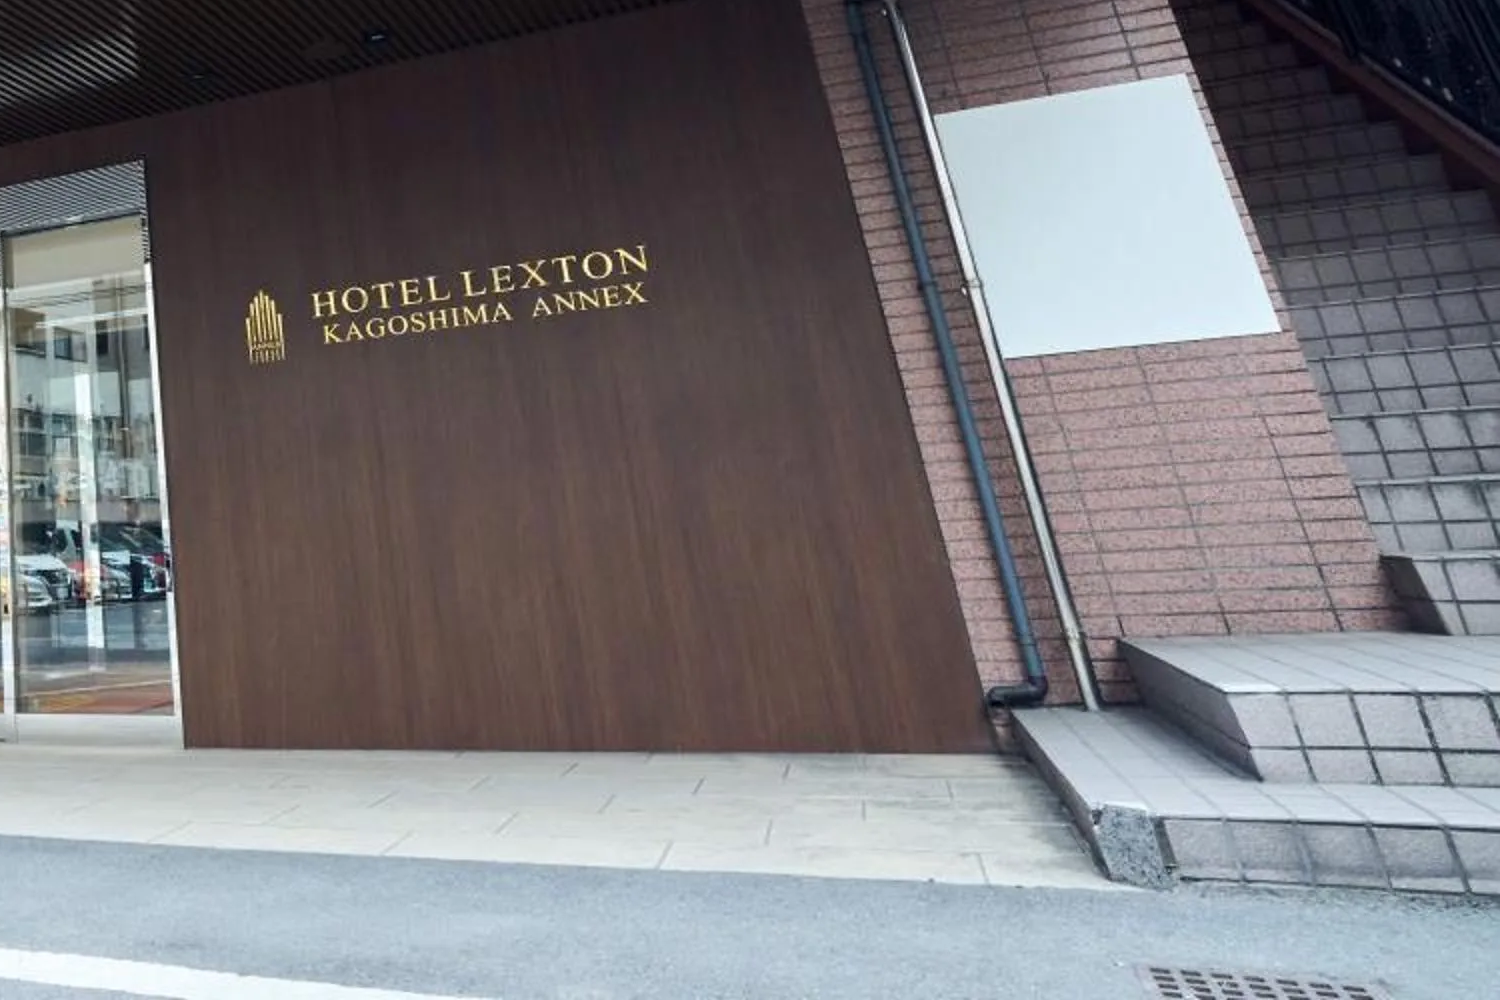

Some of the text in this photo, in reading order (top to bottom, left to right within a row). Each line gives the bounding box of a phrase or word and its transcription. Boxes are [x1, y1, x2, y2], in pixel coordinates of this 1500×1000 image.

[310, 244, 650, 319] HOTEL LEXTON
[323, 281, 650, 345] KAGOSHIMA ANNEX
